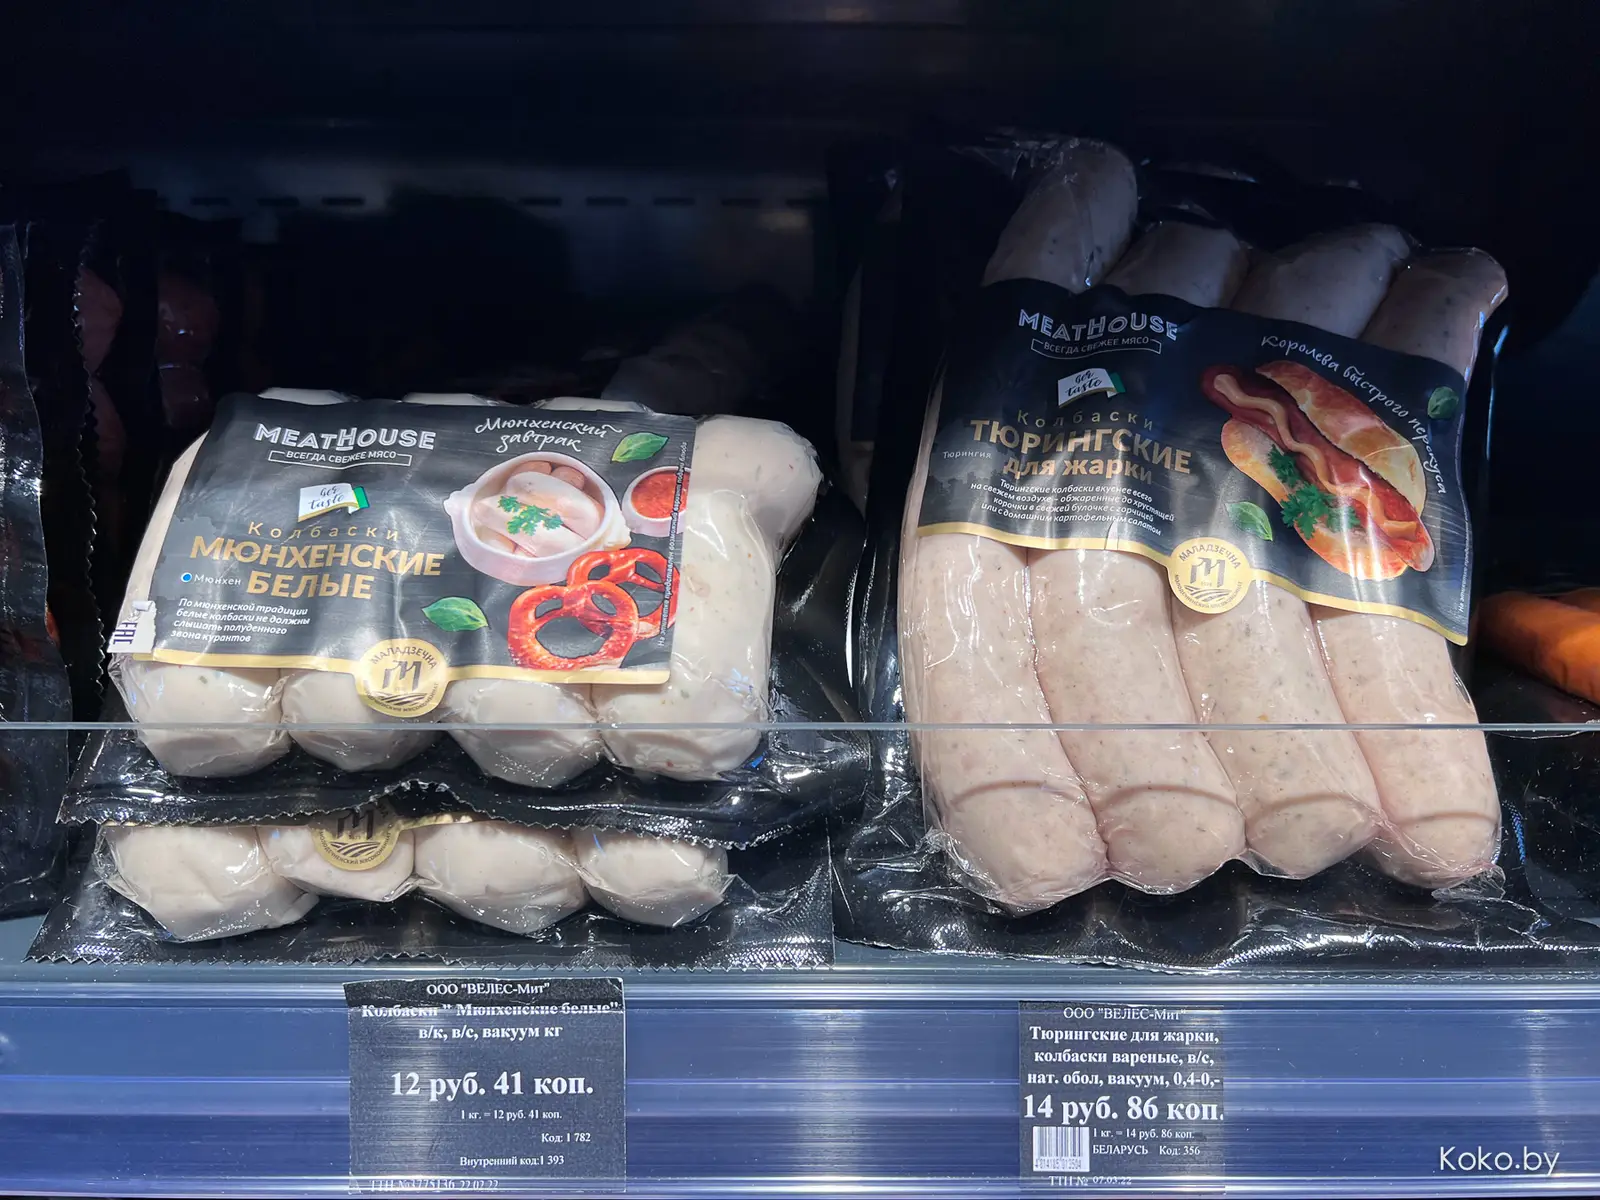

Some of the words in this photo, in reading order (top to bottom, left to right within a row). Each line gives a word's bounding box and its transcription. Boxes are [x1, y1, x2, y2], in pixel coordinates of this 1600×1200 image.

[1018, 309, 1178, 341] MEATHOUSE
[1043, 342, 1079, 355] ВСЕГДА
[1081, 338, 1119, 353] СВЕЖЕЕ
[1121, 336, 1149, 346] МЯСО
[1261, 335, 1340, 372] Королева
[1343, 366, 1409, 418] быстрого
[475, 417, 622, 438] Мюнхенский
[1017, 409, 1153, 432] Колбаски
[253, 423, 437, 451] MEATHOUSE
[496, 431, 584, 453] завтрак
[970, 419, 1192, 474] ТЮРИНГСКИЕ
[286, 450, 326, 462] ВСЕГДА
[328, 451, 366, 463] СВЕЖЕЕ
[368, 450, 397, 460] МЯСО
[1003, 457, 1056, 480] для
[1063, 458, 1153, 485] жарки
[999, 478, 1050, 494] Тюрингские
[1051, 484, 1094, 494] колбаски
[1095, 485, 1132, 495] вкуснее
[1132, 489, 1153, 503] всего
[970, 482, 982, 491] на
[983, 484, 1016, 500] свежем
[1016, 494, 1052, 504] воздухе
[1060, 493, 1121, 504] обжаренные
[1121, 496, 1133, 505] до
[1132, 499, 1175, 522] хрустящей
[993, 497, 1028, 512] корочки
[1036, 503, 1070, 514] свежей
[1071, 503, 1108, 513] булочке
[1116, 506, 1154, 522] горчицей
[981, 503, 997, 513] или
[1003, 510, 1052, 522] домашним
[1053, 513, 1127, 524] картофельным
[1128, 516, 1162, 537] салатом
[248, 521, 399, 542] Колбаски
[190, 535, 445, 576] МЮНХЕНСКИЕ
[1179, 544, 1241, 569] МАЛАДЗЕЧНА
[194, 573, 242, 586] Мюнхен
[247, 571, 376, 600] БЕЛЫЕ
[176, 608, 208, 619] белые
[209, 611, 254, 623] колбаски
[256, 615, 268, 624] не
[269, 615, 311, 626] должны
[178, 598, 192, 608] По
[193, 600, 255, 613] мюнхенской
[255, 604, 309, 616] традиции
[170, 630, 201, 640] звона
[202, 632, 252, 643] курантов
[173, 619, 222, 631] слышать
[223, 622, 288, 635] полуденного
[370, 646, 437, 669] МАЛАДЗЕЧНА
[426, 984, 458, 995] ООО
[461, 983, 550, 995] "ВЕЛЕС-Мит"
[361, 1004, 438, 1018] Колбаски
[1063, 1007, 1094, 1019] ООО
[1098, 1007, 1186, 1020] "ВЕЛЕС-Мит"
[419, 1025, 448, 1041] в/к,
[451, 1025, 479, 1041] в/с,
[482, 1028, 540, 1042] вакуум
[544, 1027, 563, 1038] кг
[1029, 1026, 1128, 1044] Тюрингские
[1130, 1030, 1159, 1043] для
[1163, 1030, 1220, 1046] жарки,
[1034, 1048, 1107, 1064] колбаски
[1112, 1053, 1183, 1067] вареные,
[1187, 1051, 1215, 1067] в/с,
[391, 1071, 420, 1096] 12
[428, 1071, 486, 1102] руб.
[493, 1071, 525, 1096] 41
[534, 1079, 594, 1096] коп.
[1027, 1073, 1059, 1085] нат.
[1063, 1071, 1103, 1087] обол,
[1107, 1074, 1170, 1088] вакуум,
[460, 1110, 466, 1119] 1
[468, 1112, 482, 1120] кг.
[493, 1110, 504, 1119] 12
[506, 1110, 526, 1122] руб.
[528, 1110, 539, 1119] 41
[542, 1111, 562, 1119] коп.
[1023, 1094, 1053, 1118] 14
[1061, 1095, 1118, 1126] руб.
[1127, 1095, 1158, 1120] 86
[1167, 1102, 1224, 1121] коп.
[541, 1132, 563, 1143] Код:
[574, 1132, 591, 1142] 782
[1093, 1129, 1098, 1138] 1
[1101, 1130, 1114, 1138] кг.
[1126, 1129, 1137, 1138] 14
[1139, 1129, 1159, 1140] руб.
[1161, 1129, 1172, 1138] 86
[1175, 1130, 1195, 1139] коп.
[1092, 1144, 1149, 1155] БЕЛАРУСЬ
[1159, 1145, 1181, 1156] Код:
[1183, 1145, 1200, 1156] 356
[460, 1156, 518, 1167] Внутренний
[547, 1155, 565, 1165] 393
